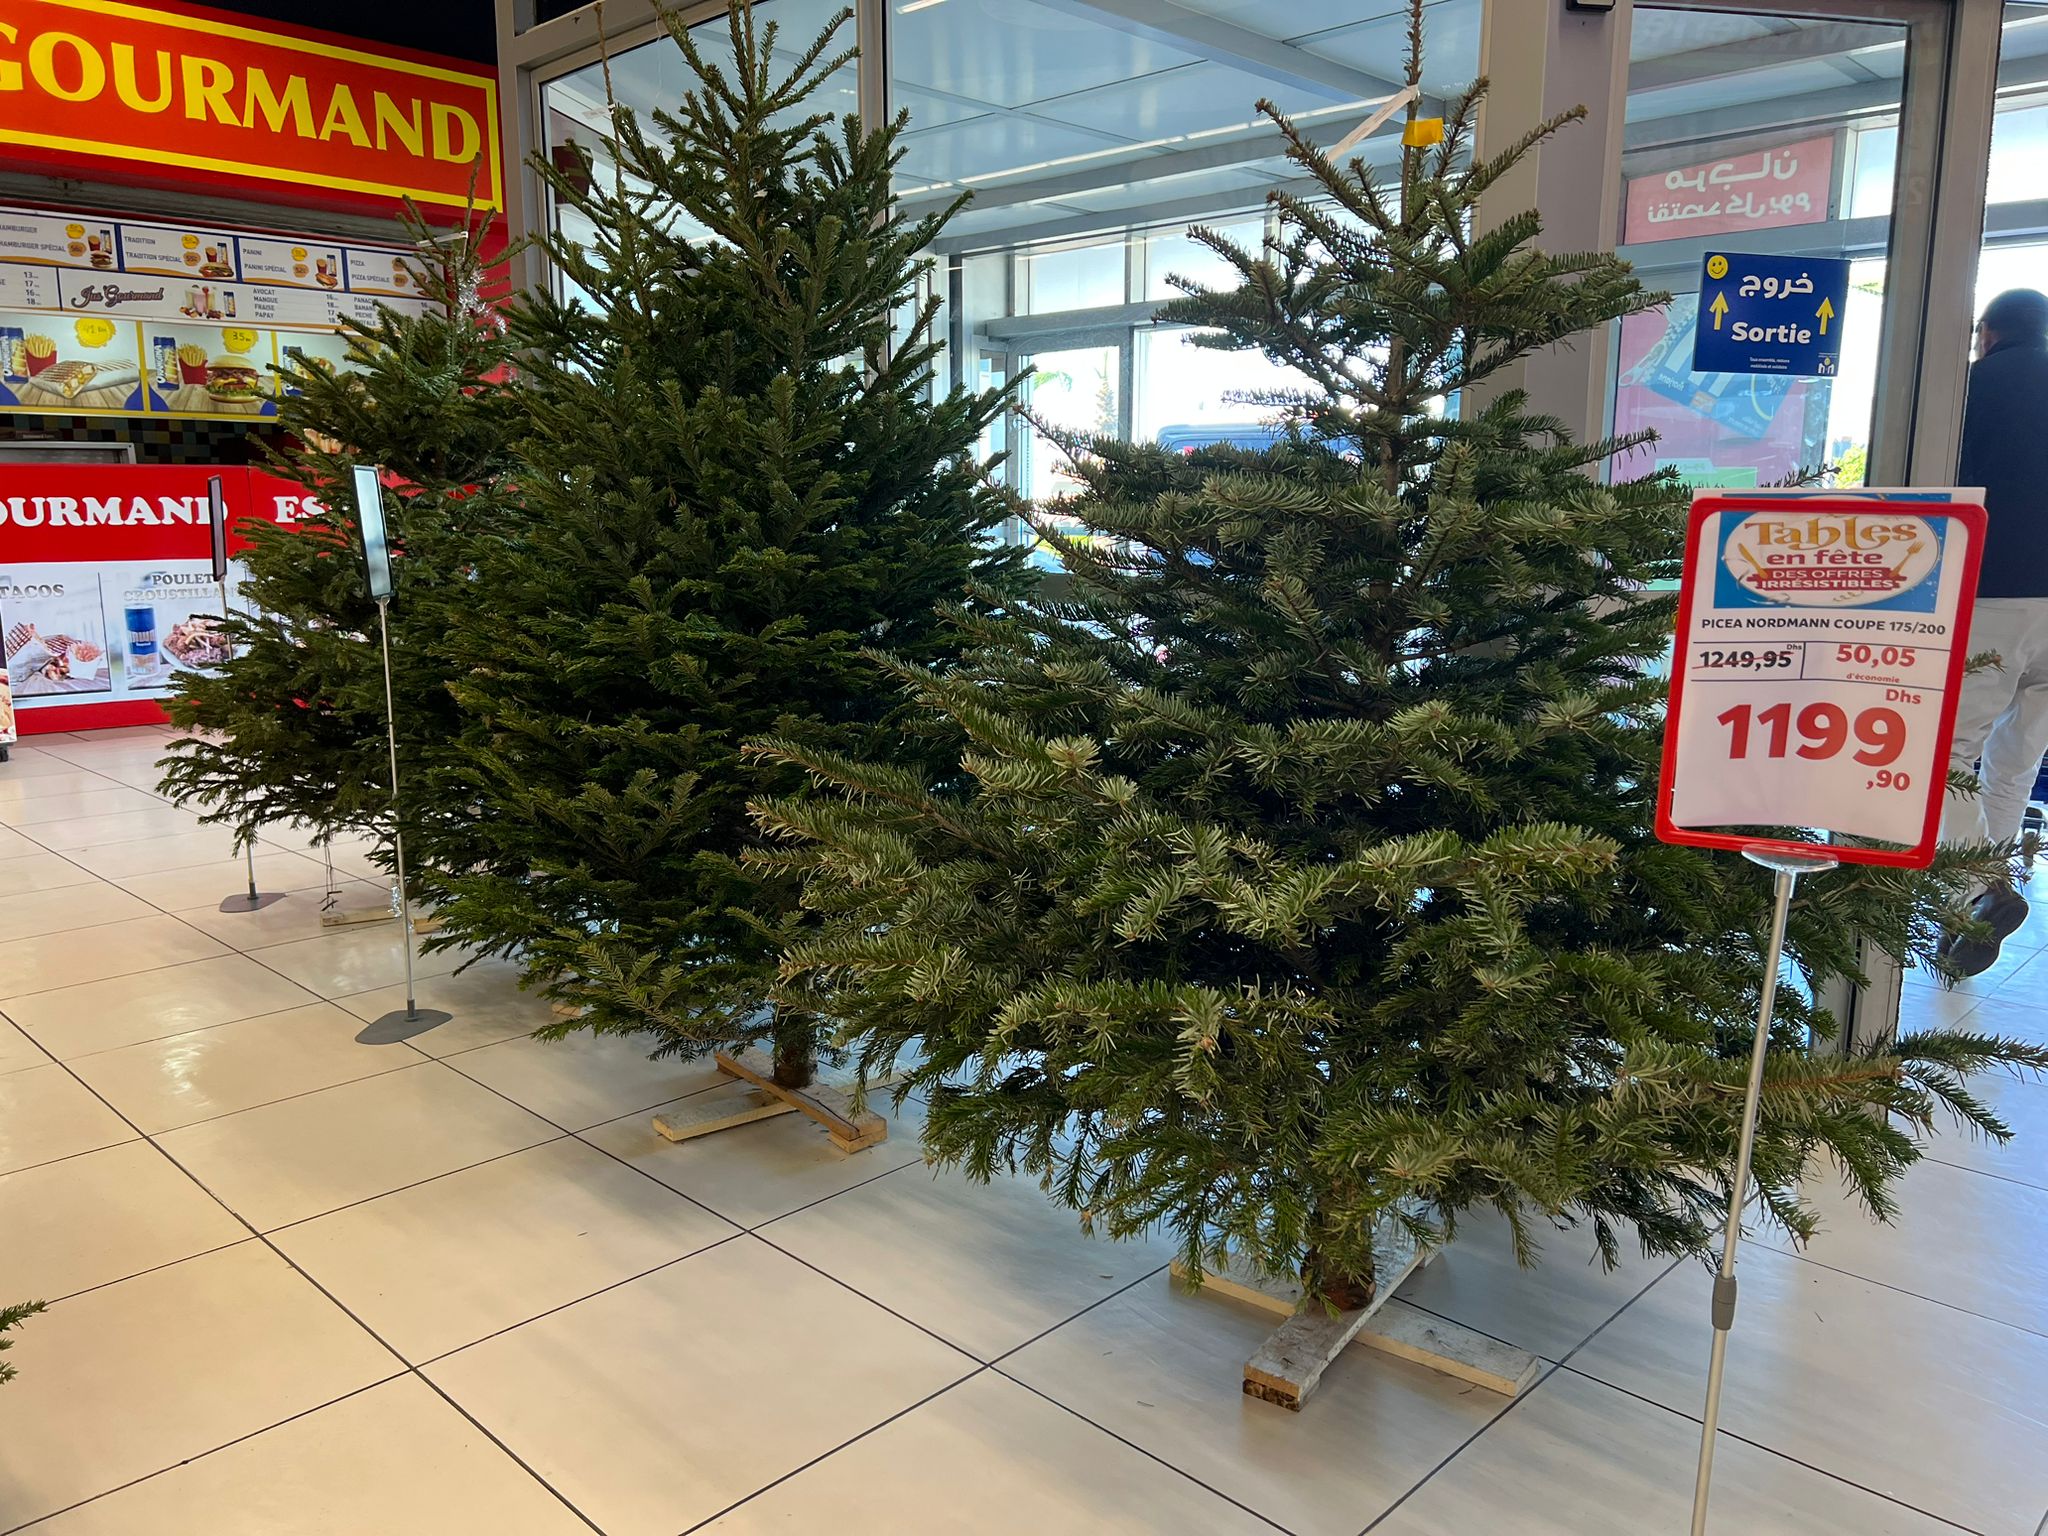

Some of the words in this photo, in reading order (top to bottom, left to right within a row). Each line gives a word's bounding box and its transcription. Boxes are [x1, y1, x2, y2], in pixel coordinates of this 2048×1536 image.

[1739, 272, 1814, 300] خروج
[1731, 322, 1811, 344] Sortie
[1744, 515, 1917, 551] Tables
[1767, 552, 1807, 565] en
[1813, 549, 1884, 565] fête
[152, 573, 215, 585] POULET
[1772, 569, 1807, 579] DES
[1811, 569, 1883, 579] OFFRES
[0, 584, 65, 600] TACOS
[1762, 578, 1894, 589] IRRÉSISTIBLES
[1702, 618, 1743, 629] PICEA
[1746, 617, 1830, 629] NORDMANN
[1834, 618, 1885, 631] COUPE
[1889, 621, 1946, 635] 175/200
[1699, 650, 1792, 671] 1249,95
[1836, 643, 1916, 668] 50,05
[1846, 672, 1900, 684] d'économie
[1885, 688, 1922, 705] Dhs
[1716, 702, 1907, 767] 1199
[1865, 769, 1911, 791] ,90
